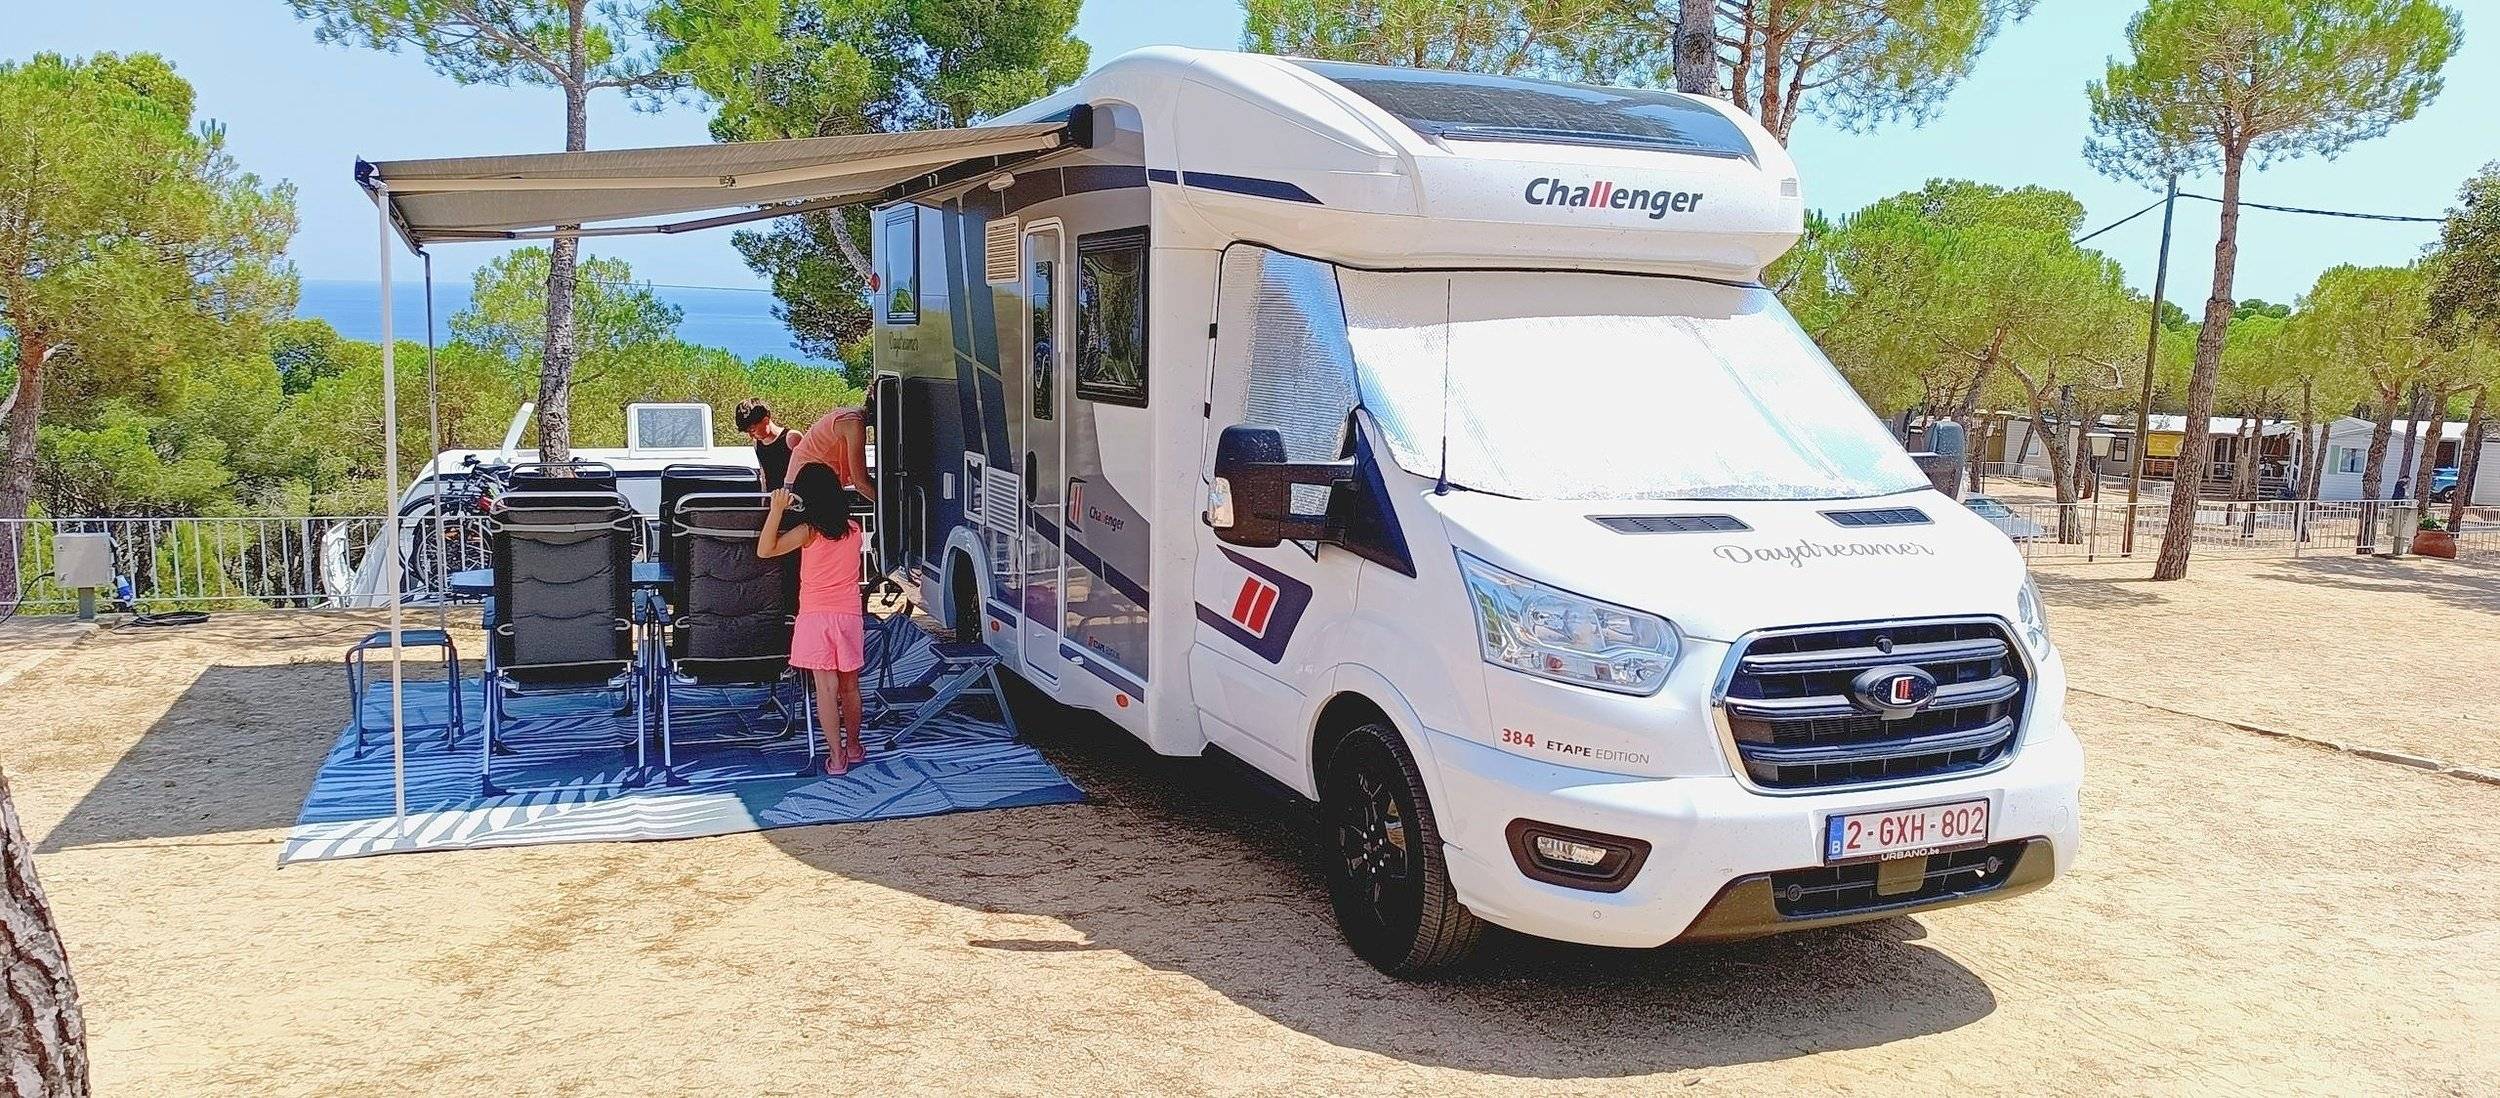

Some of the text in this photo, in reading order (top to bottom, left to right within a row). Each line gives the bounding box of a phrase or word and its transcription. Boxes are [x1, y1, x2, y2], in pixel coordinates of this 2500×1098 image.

[1524, 177, 1704, 220] Challenger
[1713, 539, 1934, 568] Daydreamer
[1502, 728, 1650, 765] 384 ETAPE EDITION
[1831, 841, 1841, 854] B
[1881, 848, 1940, 861] URBANO.be
